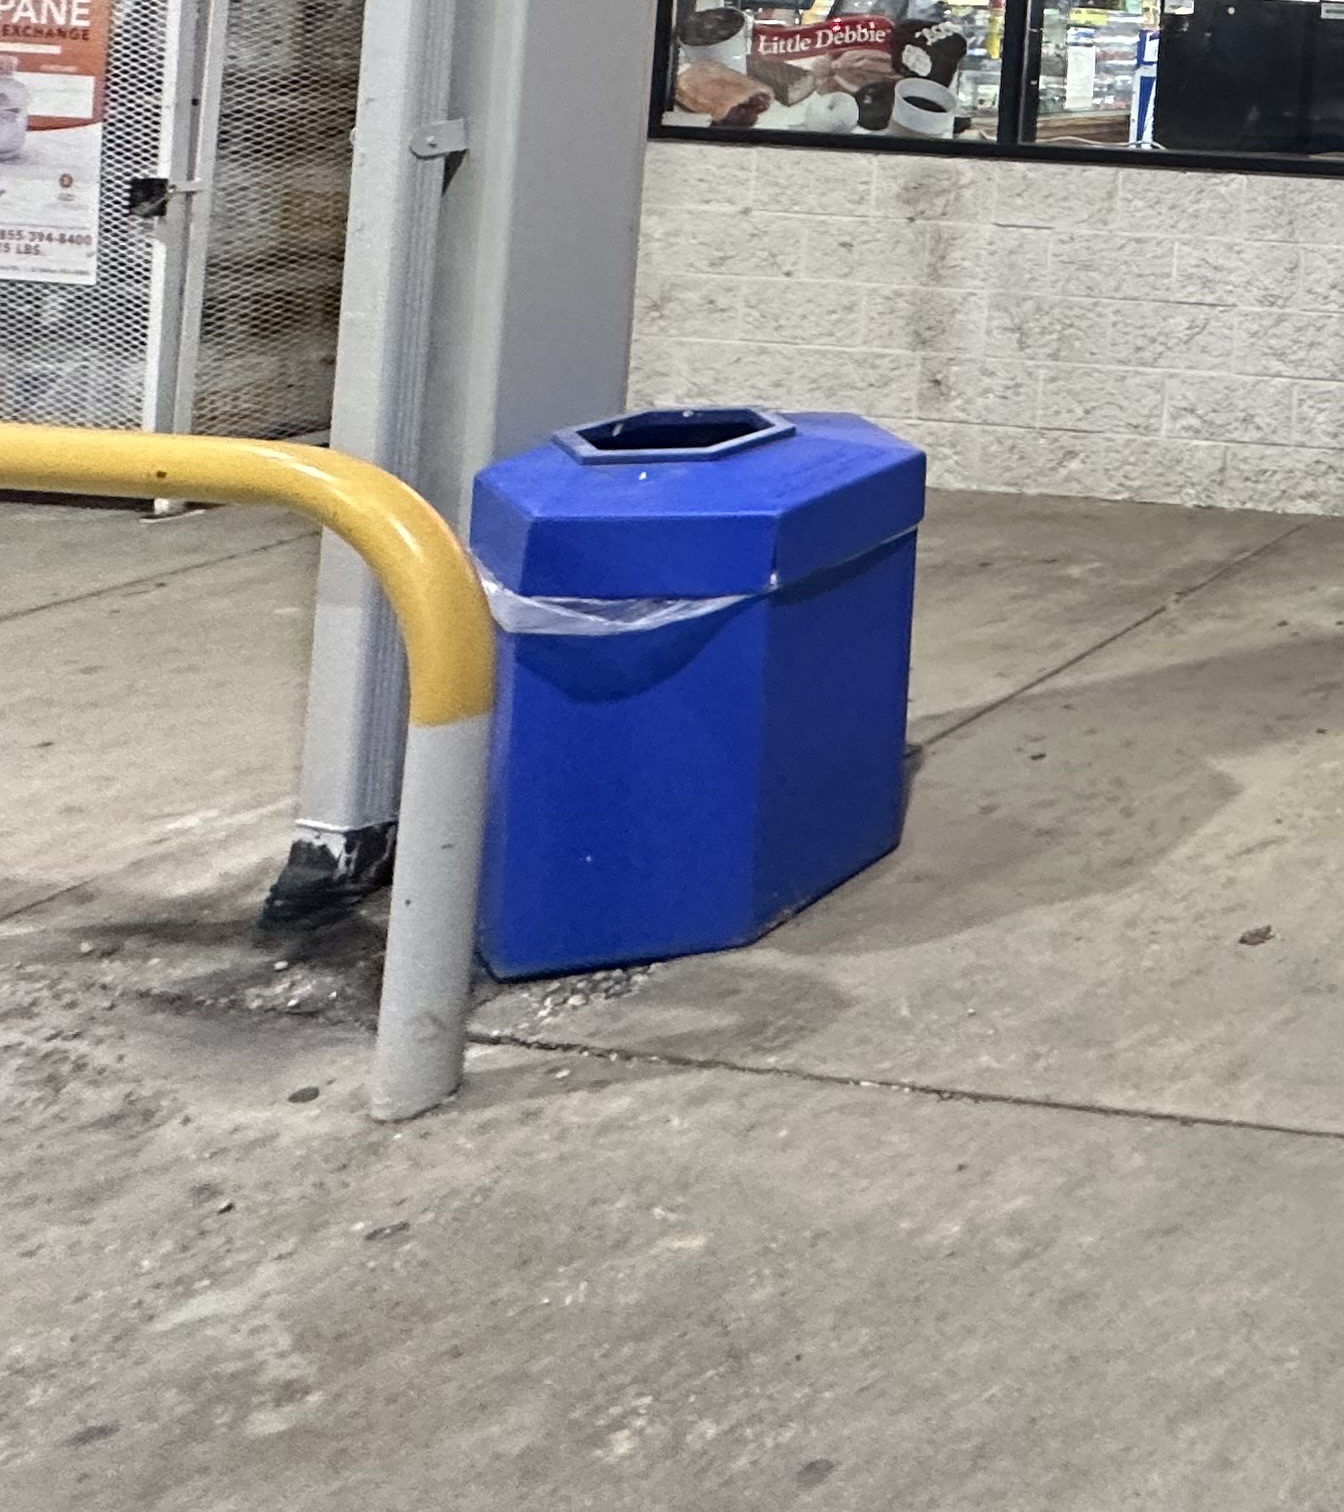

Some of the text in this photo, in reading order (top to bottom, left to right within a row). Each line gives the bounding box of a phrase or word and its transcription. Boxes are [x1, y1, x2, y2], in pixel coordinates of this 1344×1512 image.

[2, 24, 90, 41] EXCHANGE
[757, 33, 812, 56] Little
[815, 23, 887, 50] Debbie
